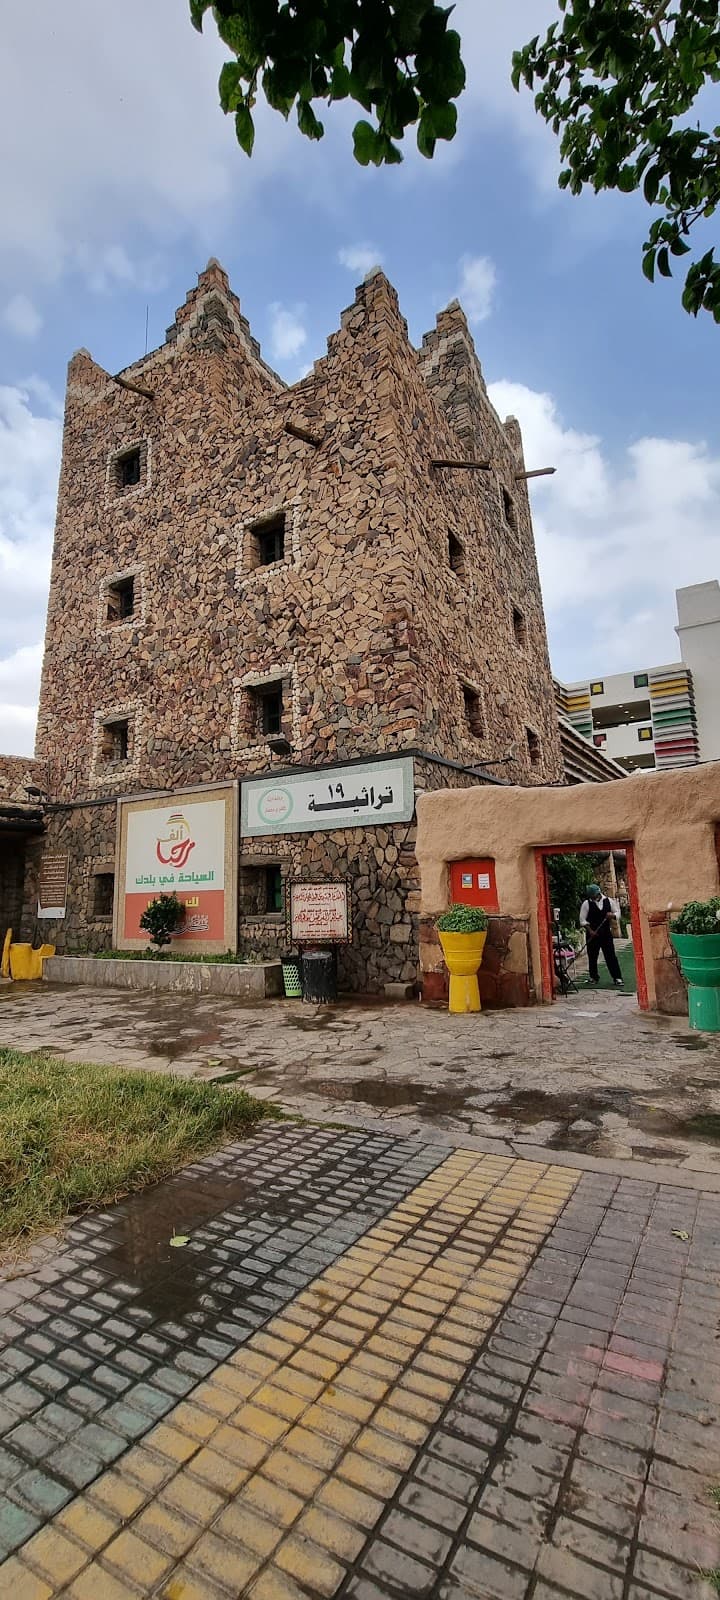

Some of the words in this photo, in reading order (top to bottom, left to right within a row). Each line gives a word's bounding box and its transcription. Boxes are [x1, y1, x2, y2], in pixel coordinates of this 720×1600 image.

[327, 782, 345, 799] ١٩
[307, 785, 394, 813] تراثية
[135, 874, 156, 887] بلدك
[159, 873, 175, 886] في
[178, 870, 215, 885] السياحة
